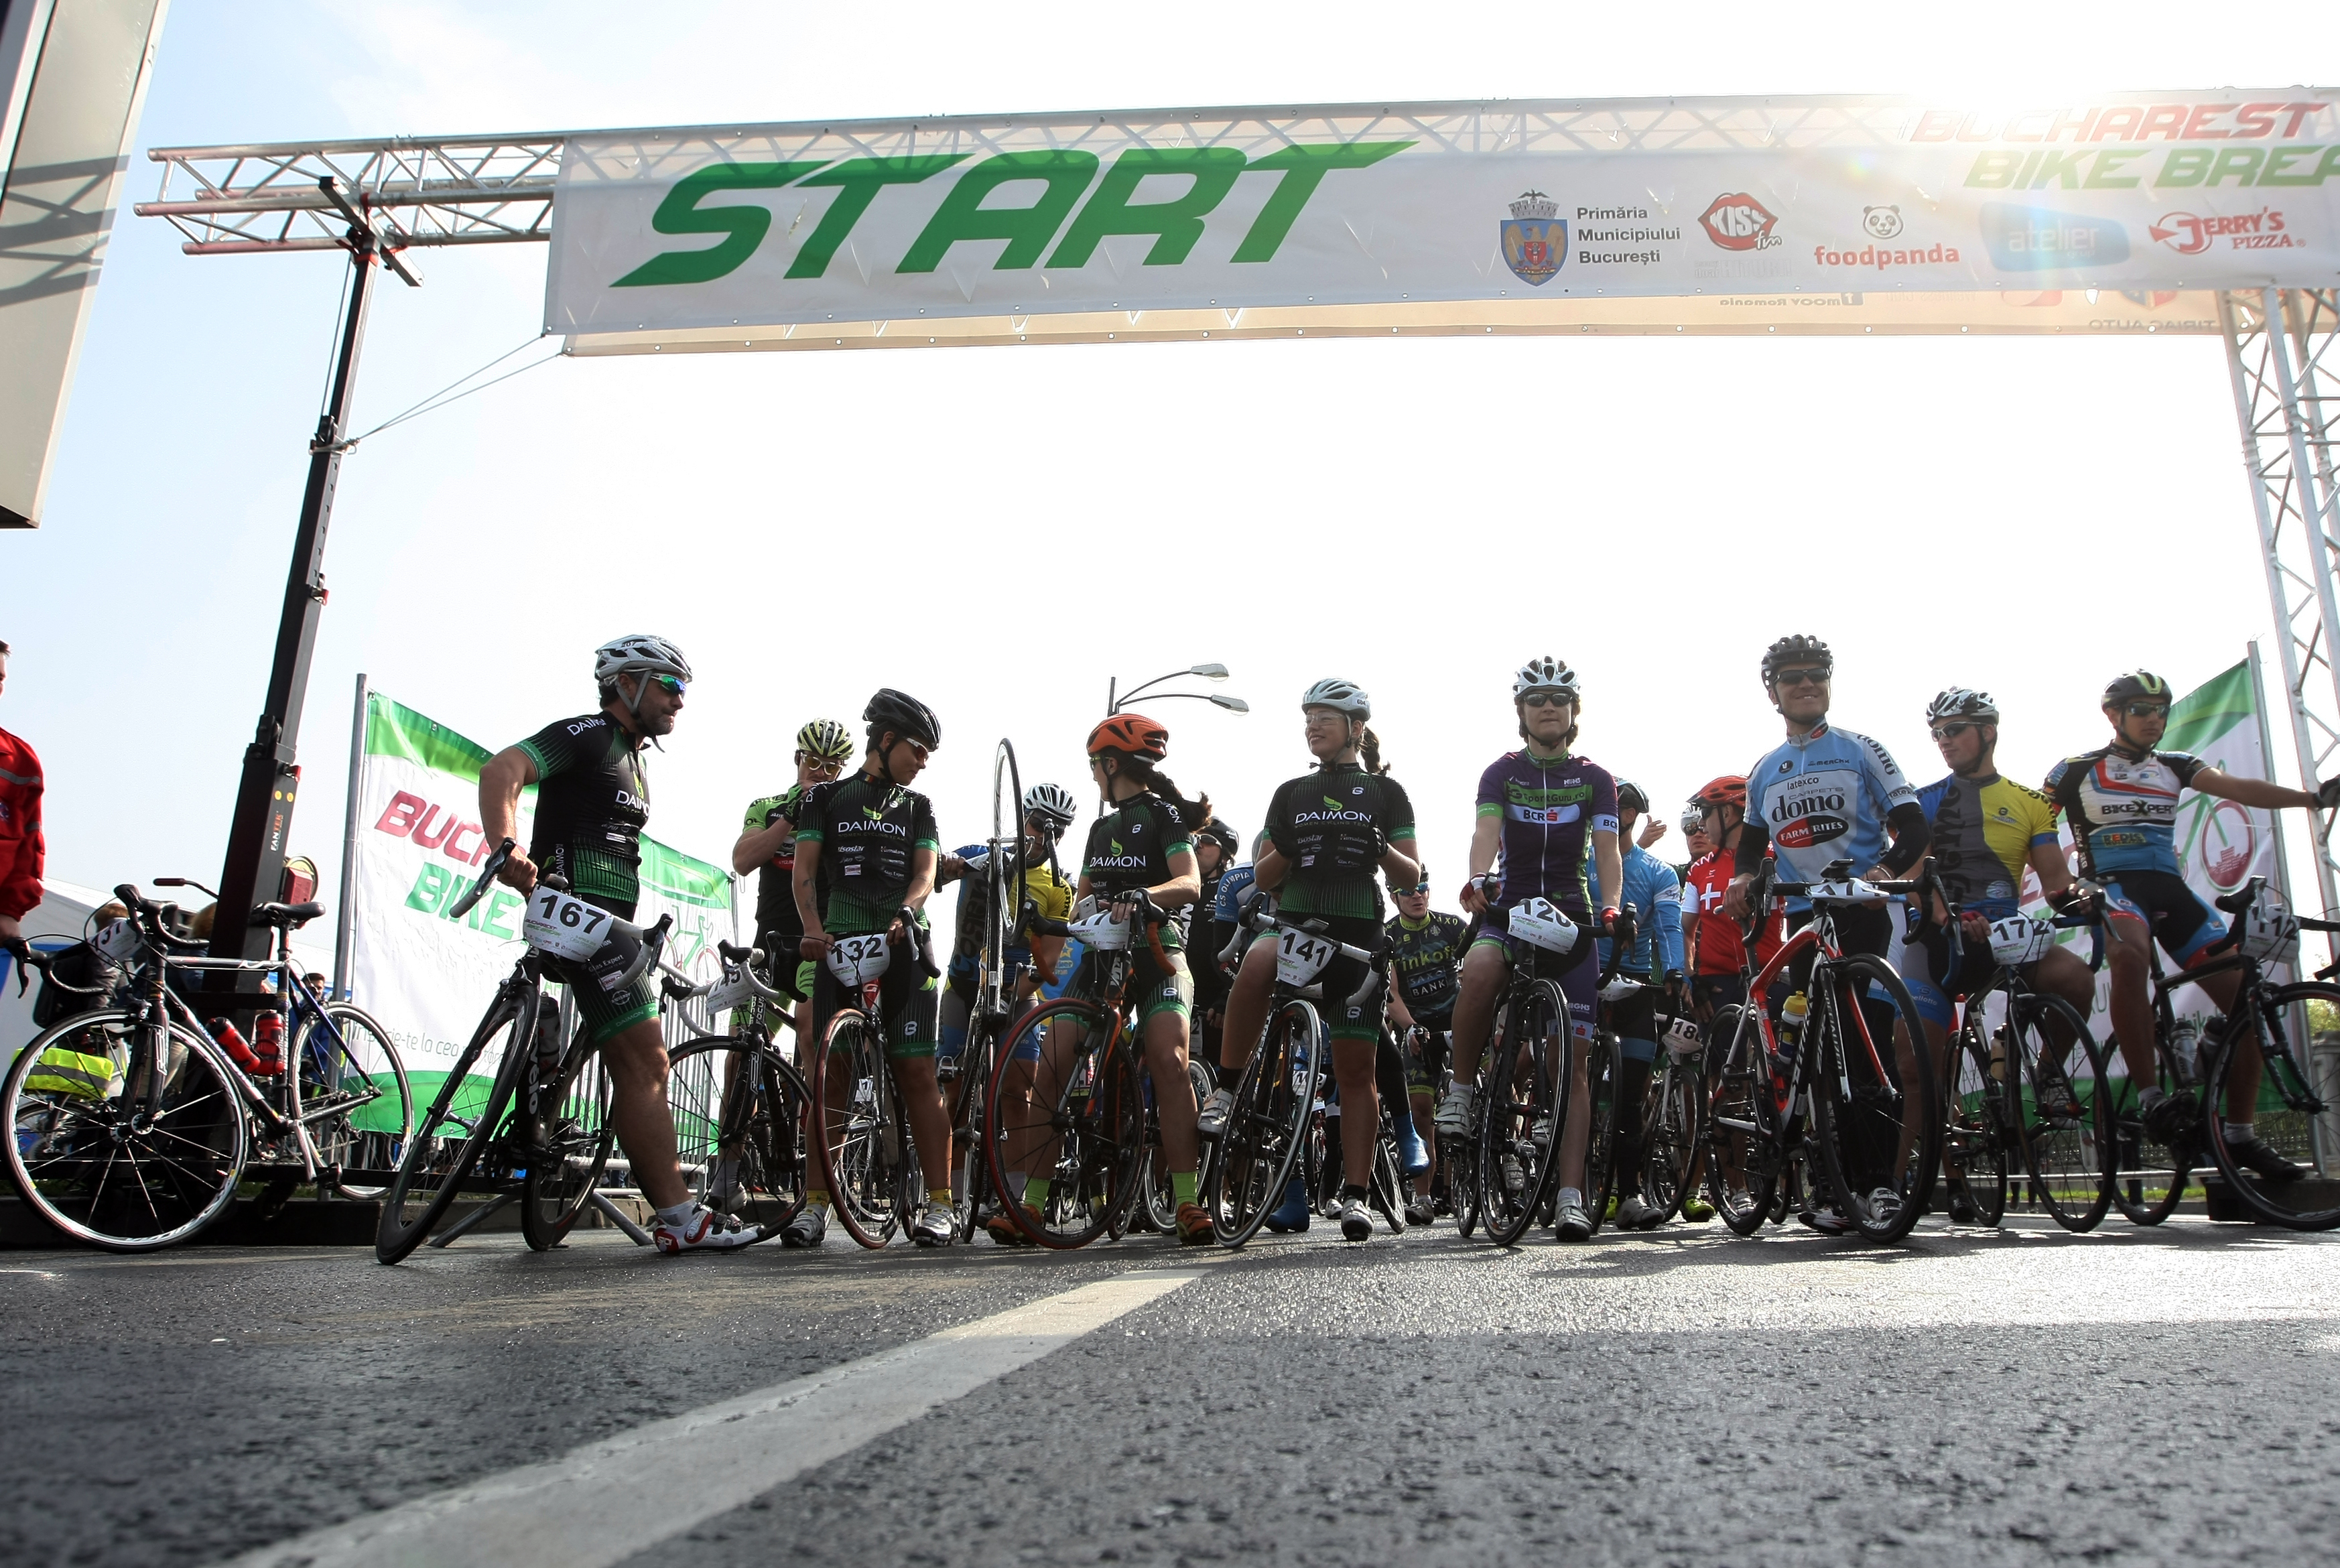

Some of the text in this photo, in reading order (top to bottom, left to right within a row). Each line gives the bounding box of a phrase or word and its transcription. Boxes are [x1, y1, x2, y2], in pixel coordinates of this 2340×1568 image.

[1910, 103, 2330, 143] BUCHAREST
[1963, 148, 2154, 190] BIKE
[609, 141, 1419, 287] START
[1577, 206, 1648, 220] Primăria
[1709, 205, 1768, 237] KISS
[1578, 226, 1681, 243] Municipiului
[2009, 219, 2100, 252] atelier
[2176, 206, 2286, 252] JERRY'S
[1755, 230, 1783, 251] fm
[2233, 233, 2294, 250] PIZZA
[1814, 242, 1961, 270] foodpanda
[1787, 777, 1820, 791] latexco
[1295, 811, 1372, 824] DAIMON
[1523, 809, 1546, 822] BCR
[1771, 793, 1845, 824] domo
[838, 820, 905, 836] DAIMON
[1780, 828, 1809, 841] FARM
[1090, 856, 1147, 867] DAIMON
[1220, 871, 1251, 893] OLIMPIA
[1220, 895, 1227, 907] CS
[539, 894, 606, 935] 167
[1994, 919, 2051, 941] 172
[831, 937, 883, 964] 132
[1283, 932, 1327, 968] 141
[1413, 979, 1446, 996] BANK
[421, 1036, 432, 1053] la
[436, 1040, 459, 1057] cea
